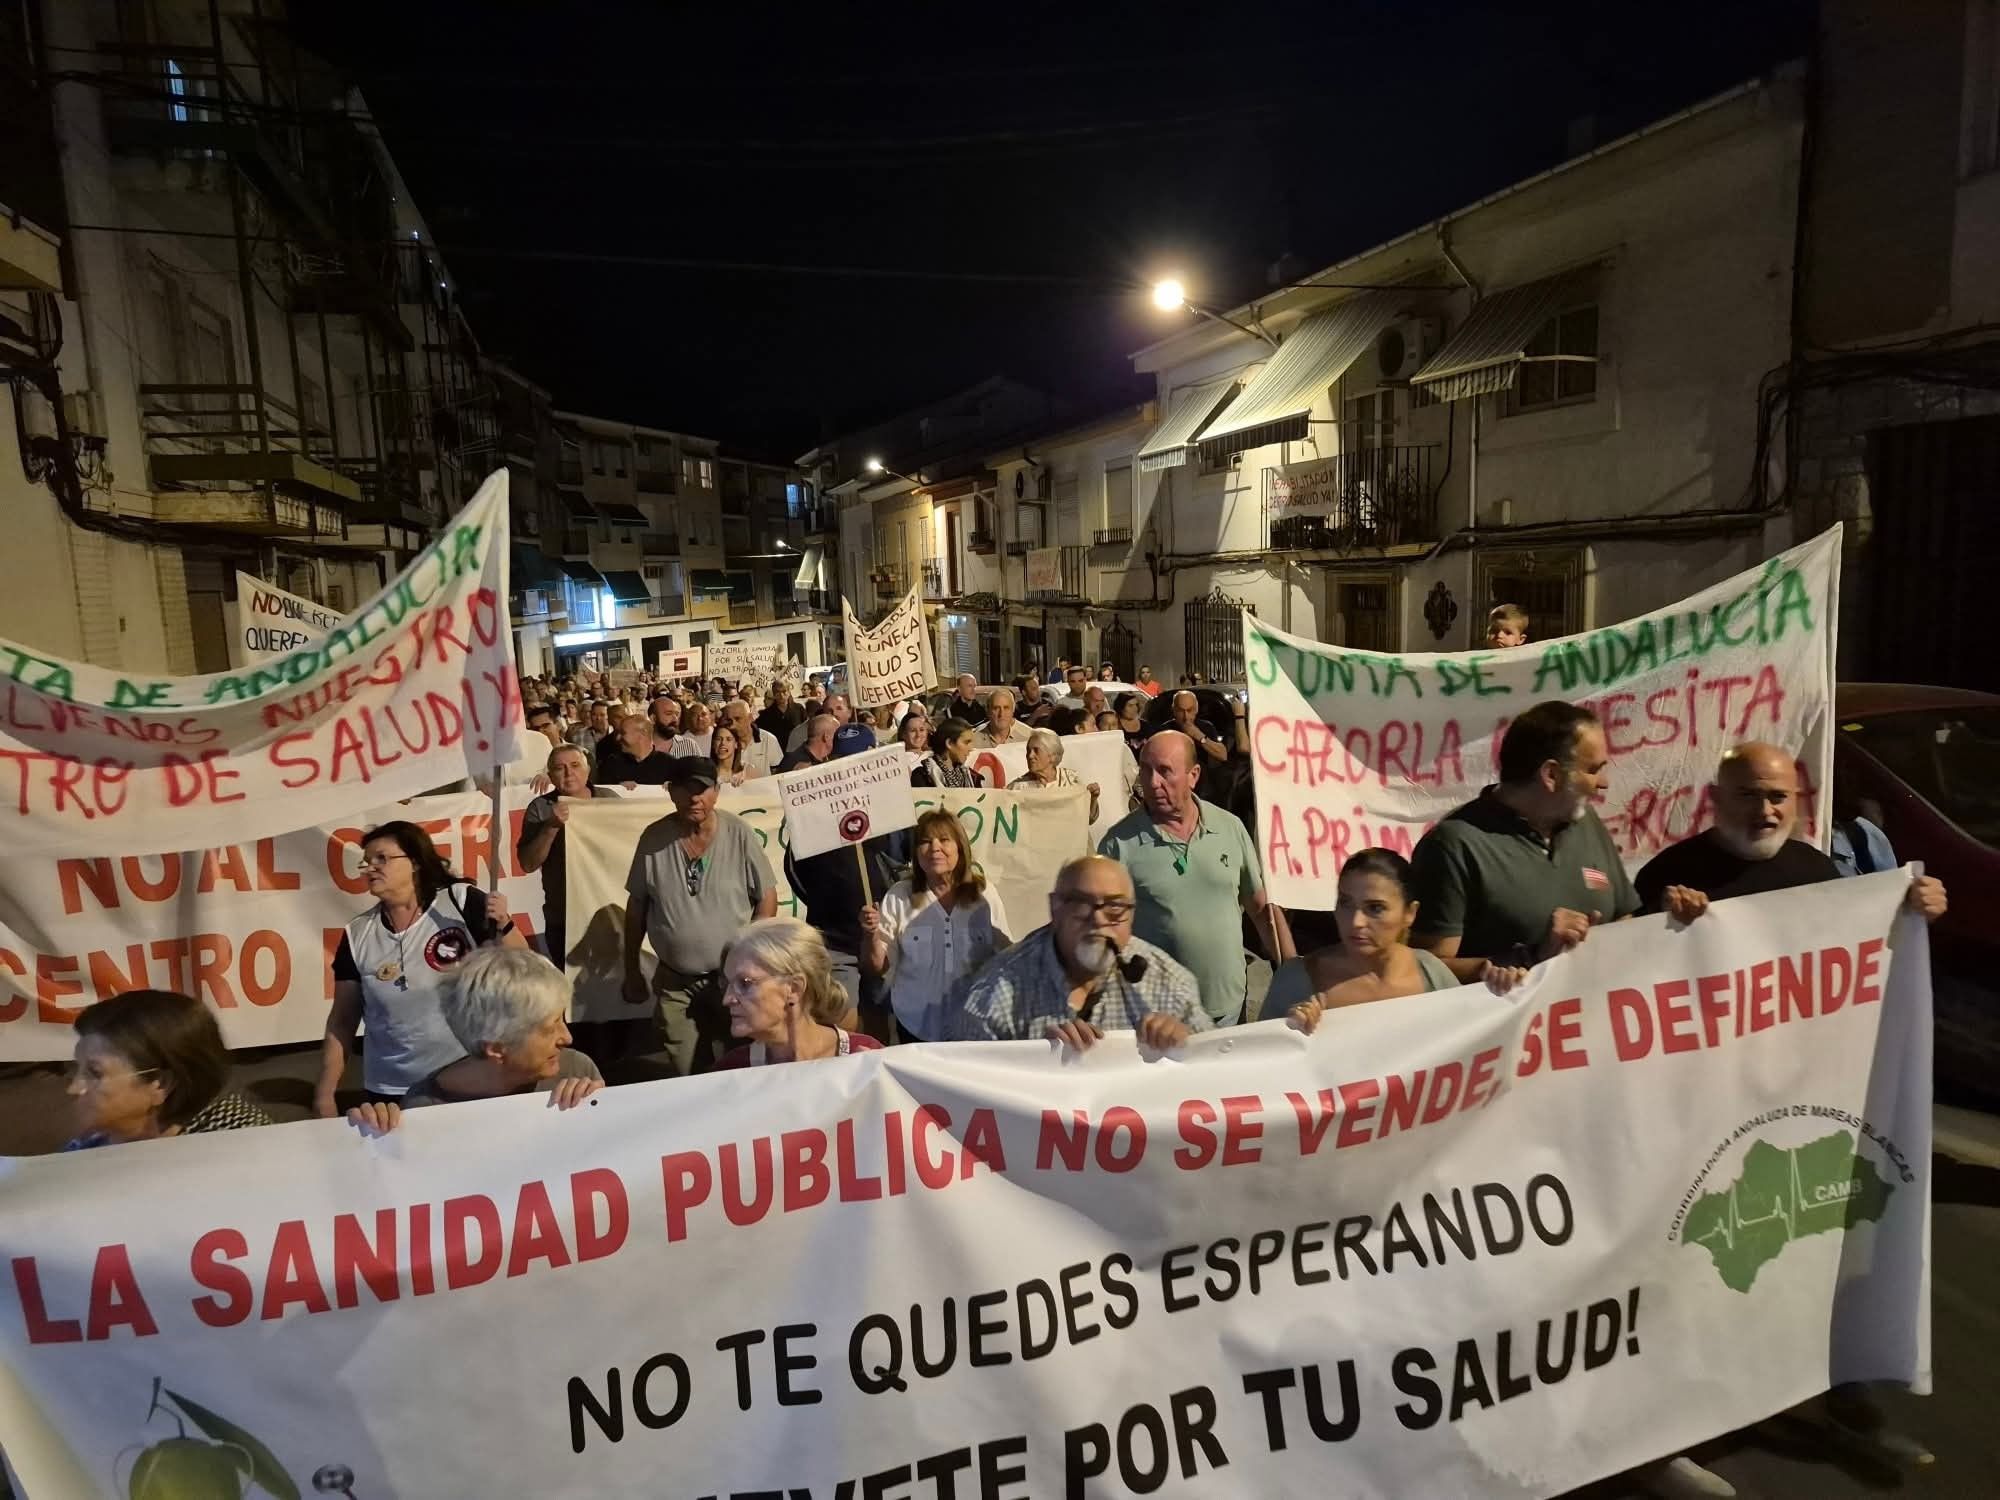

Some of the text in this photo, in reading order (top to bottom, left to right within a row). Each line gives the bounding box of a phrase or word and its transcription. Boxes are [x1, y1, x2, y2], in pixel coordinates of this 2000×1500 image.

[252, 590, 281, 615] NO
[1249, 557, 1814, 700] JUNTA DE ANDALUCÍA
[104, 680, 182, 708] DE
[262, 587, 497, 727] NUESTRO
[859, 655, 902, 679] ALUD
[162, 748, 246, 807] DE
[791, 766, 902, 807] CENTRO DE SALUD
[1254, 714, 1464, 787] CAZORLA
[57, 850, 181, 915] NO
[197, 838, 301, 894] AL
[11, 1243, 159, 1344] LA
[190, 1167, 630, 1328] SANIDAD
[661, 1102, 1007, 1243] PUBLICA
[1036, 1106, 1148, 1173] NO
[1174, 1094, 1264, 1171] SE
[1516, 998, 1590, 1078] SE
[1607, 937, 1885, 1063] DEFIENDE
[1667, 1104, 1914, 1242] COORDINADORA ANDALUZA DE MAREAS BLANCAS
[566, 1173, 1575, 1454] NO TE QUEDES ESPERANDO
[1064, 1384, 1229, 1500] POR
[1241, 1359, 1361, 1452] TU
[1391, 1286, 1641, 1431] SALUD!
